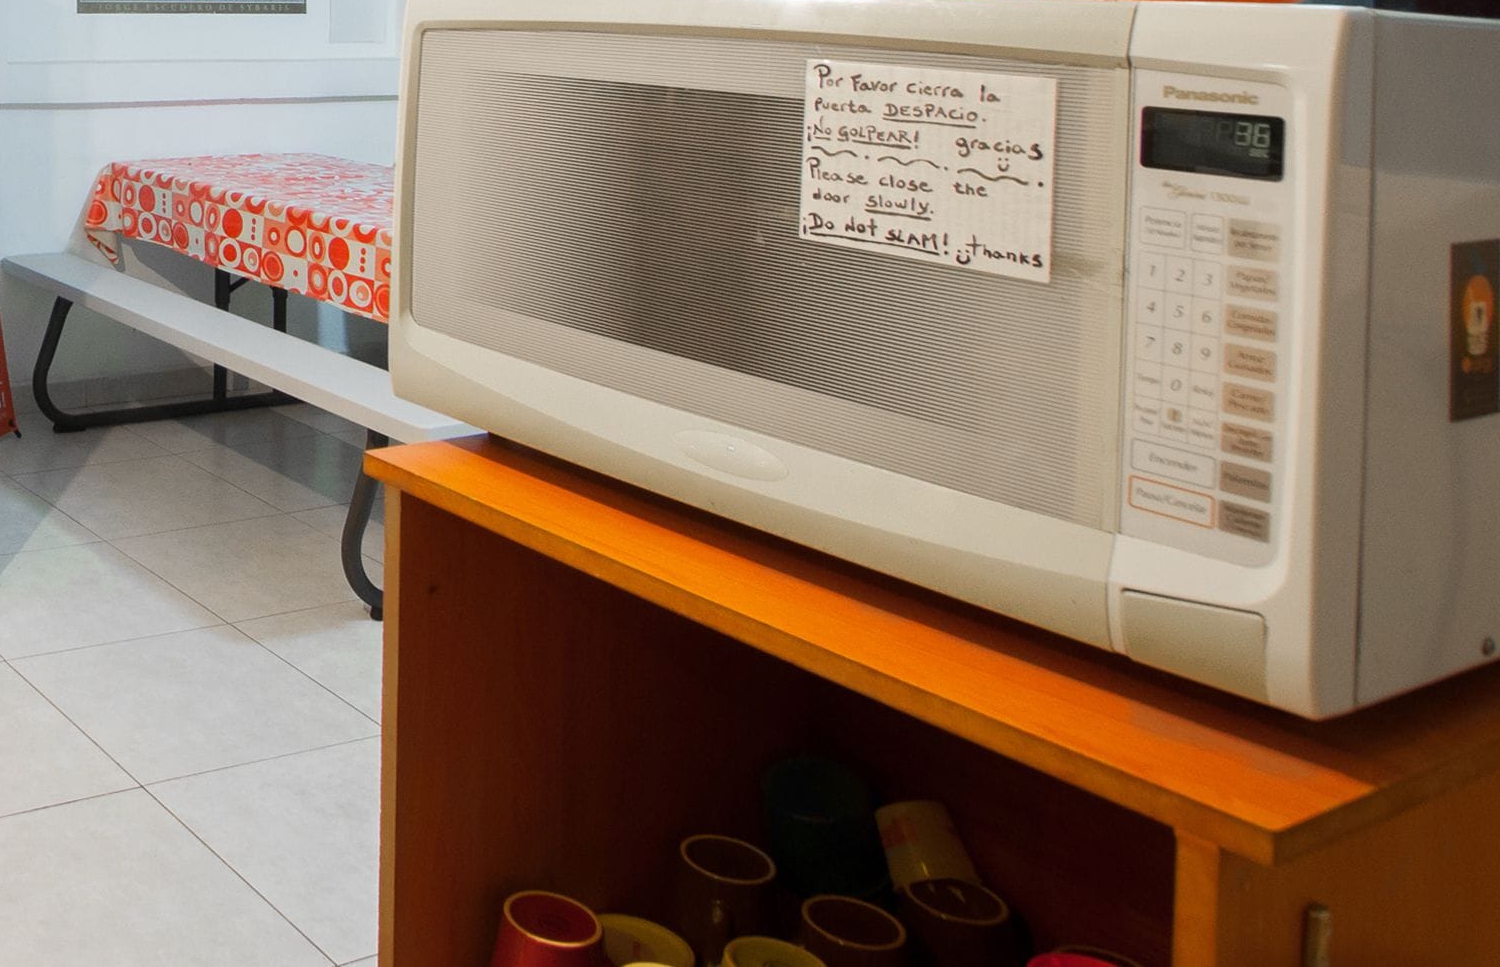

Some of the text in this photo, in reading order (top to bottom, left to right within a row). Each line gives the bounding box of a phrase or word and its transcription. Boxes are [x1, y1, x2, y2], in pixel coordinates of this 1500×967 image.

[813, 63, 844, 89] Por
[906, 80, 964, 99] cierra
[980, 84, 1000, 103] la
[1162, 85, 1259, 105] Panasonic
[955, 136, 1044, 161] gracias
[806, 156, 989, 198] Please close the
[812, 188, 851, 204] door
[964, 234, 1044, 268] thanks
[1174, 268, 1186, 282] 2
[1202, 273, 1213, 286] 3
[1146, 301, 1156, 314] 4
[1173, 305, 1185, 318] 5
[1201, 310, 1213, 323] 6
[1147, 335, 1156, 348] 7
[1171, 341, 1184, 355] 8
[1201, 347, 1212, 361] 9
[1170, 379, 1182, 391] 0
